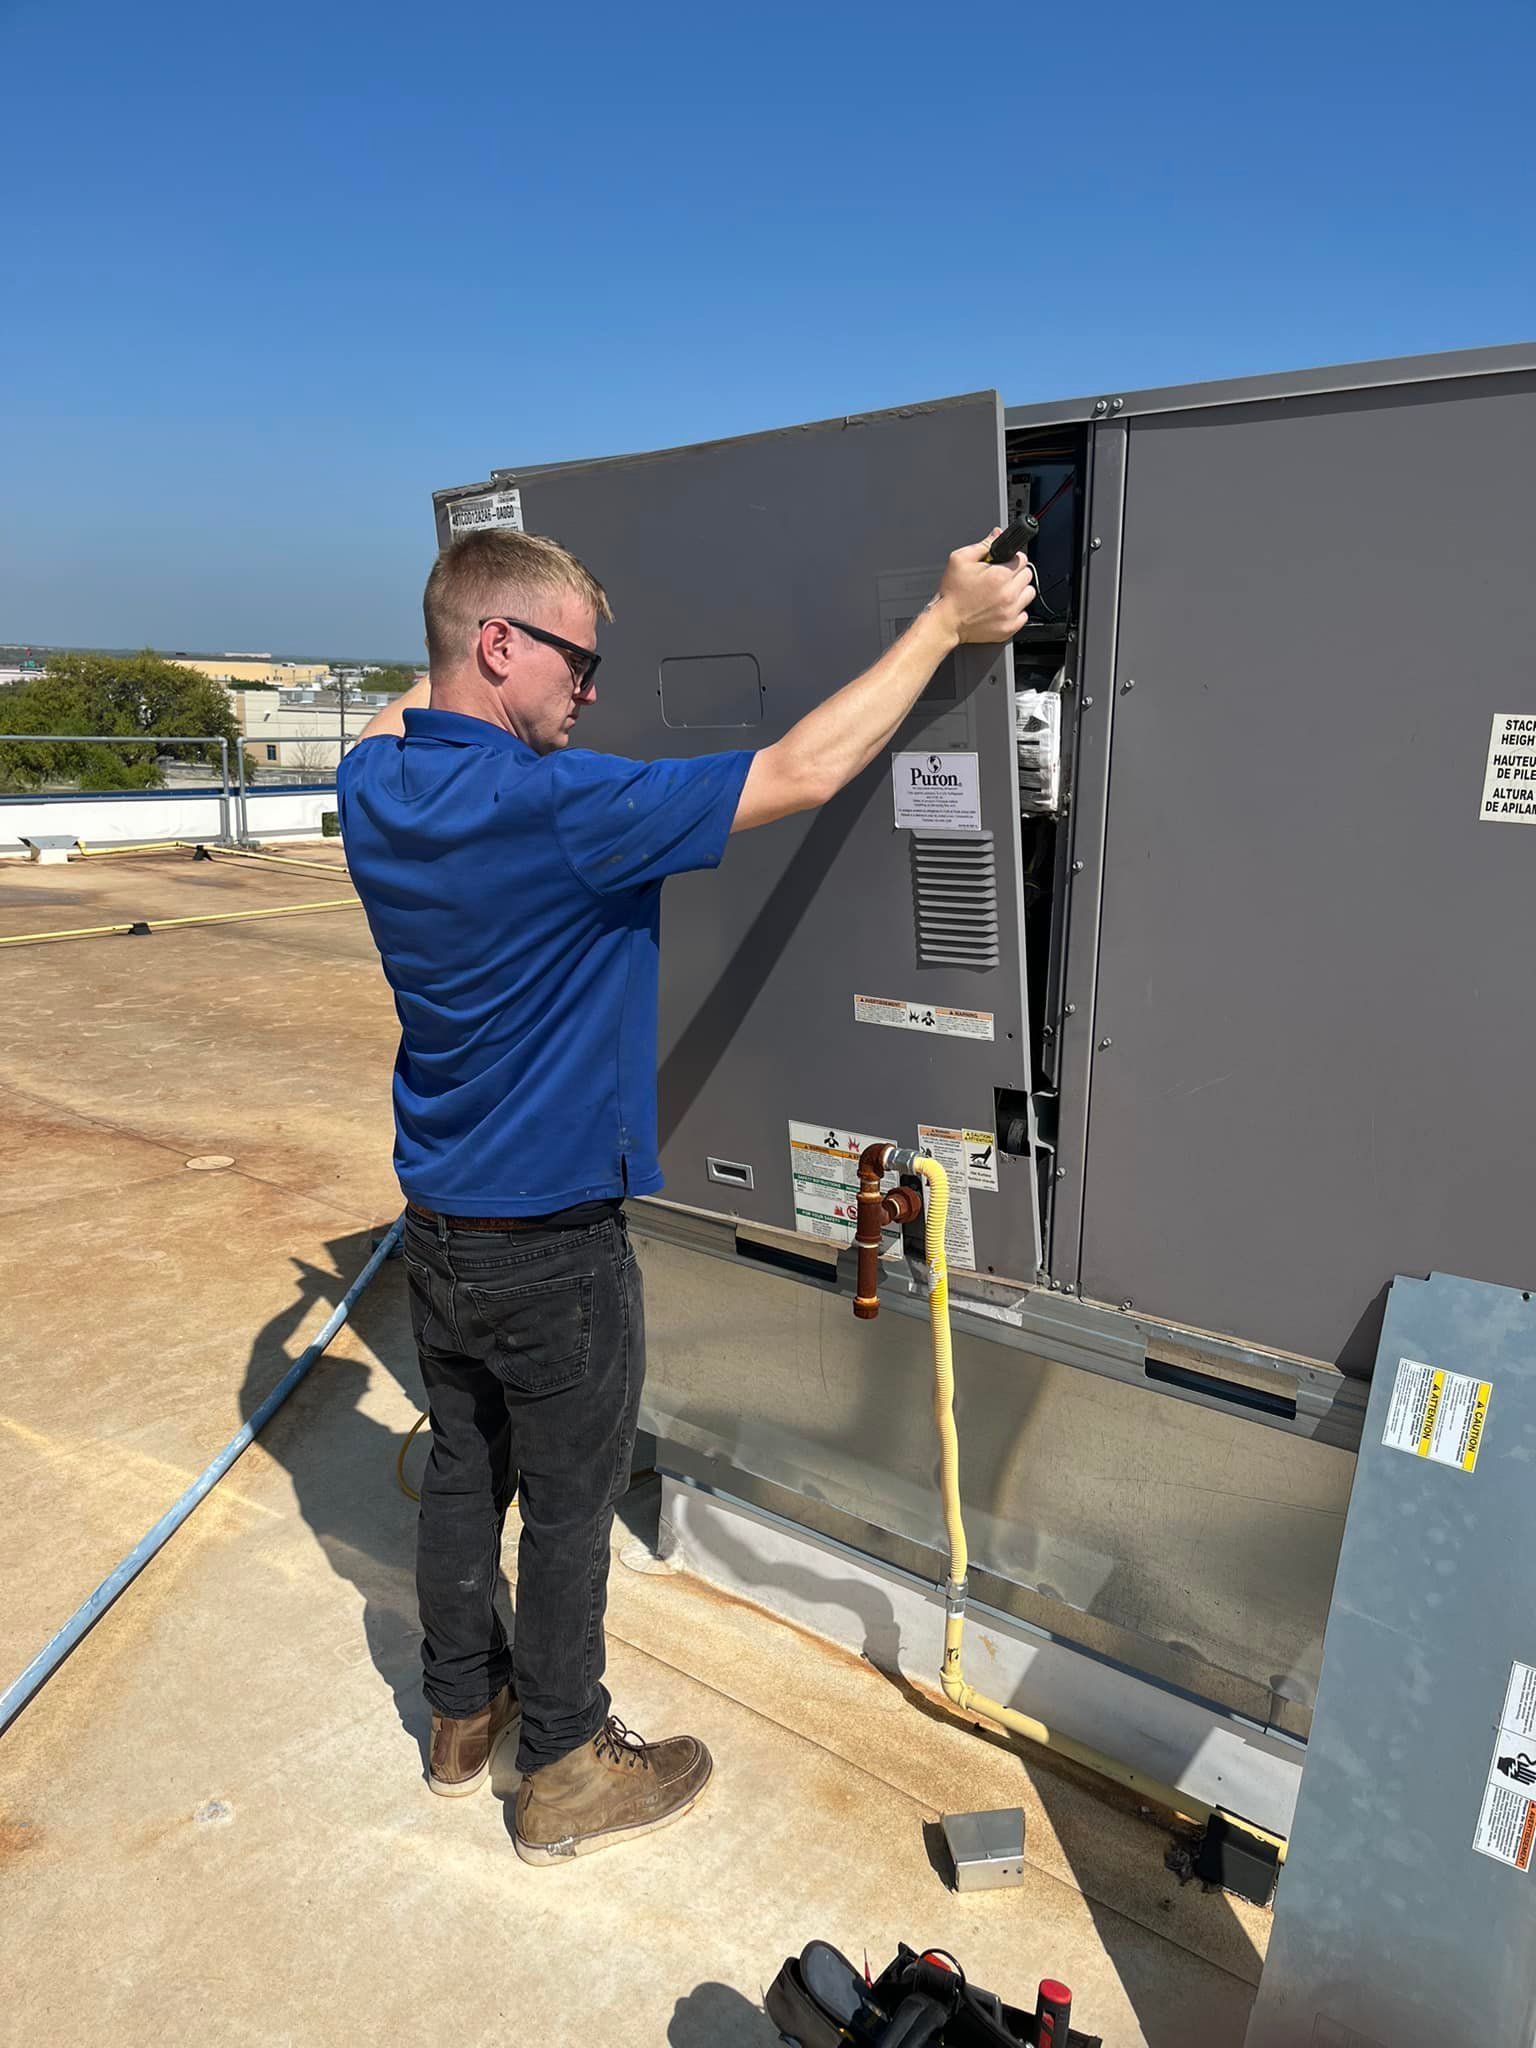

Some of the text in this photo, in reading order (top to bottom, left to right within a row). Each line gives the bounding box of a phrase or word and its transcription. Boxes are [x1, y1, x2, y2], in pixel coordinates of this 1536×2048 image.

[1501, 734, 1536, 746] HEIGH
[1497, 768, 1536, 781] DE PILE
[1492, 787, 1534, 801] ALTURA
[1485, 801, 1499, 813] DE
[1422, 1392, 1439, 1440] ATTENTION
[1467, 1411, 1484, 1453] CAUTION
